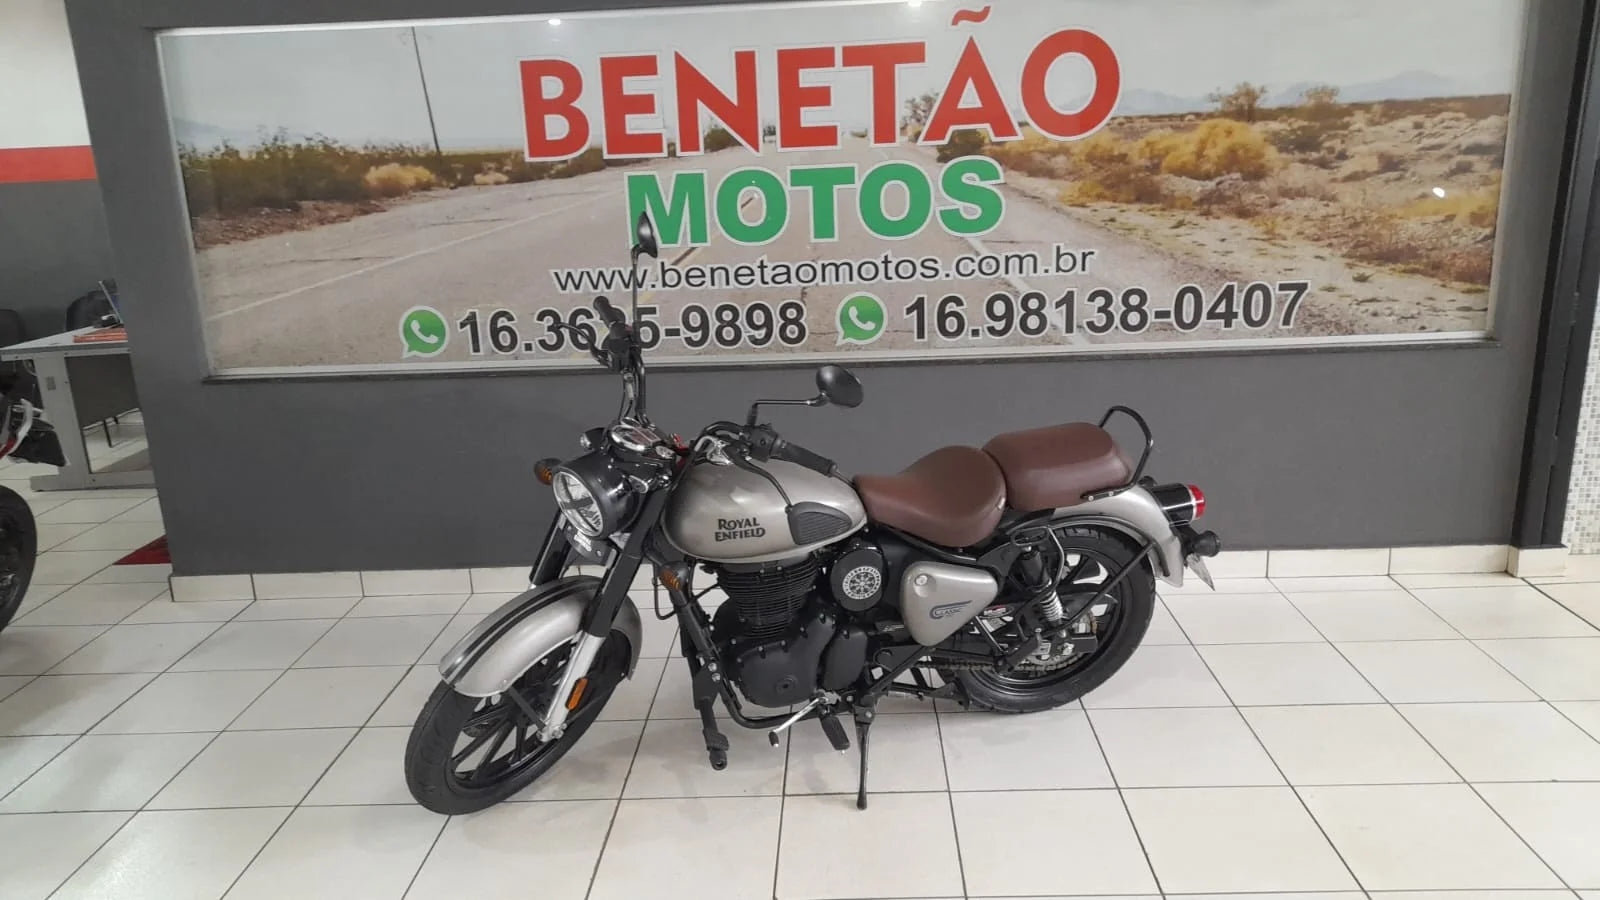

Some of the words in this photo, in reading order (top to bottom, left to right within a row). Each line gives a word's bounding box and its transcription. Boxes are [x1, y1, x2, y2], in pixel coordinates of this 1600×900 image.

[519, 6, 1121, 161] BENETÃO
[626, 157, 1004, 247] MOTOS
[553, 246, 1094, 291] www.benetaomotos.com.br
[459, 301, 807, 354] 16.365-9898
[905, 282, 1308, 340] 16.98138-0407
[715, 527, 766, 542] ENFIELD
[718, 517, 760, 531] ROYAL
